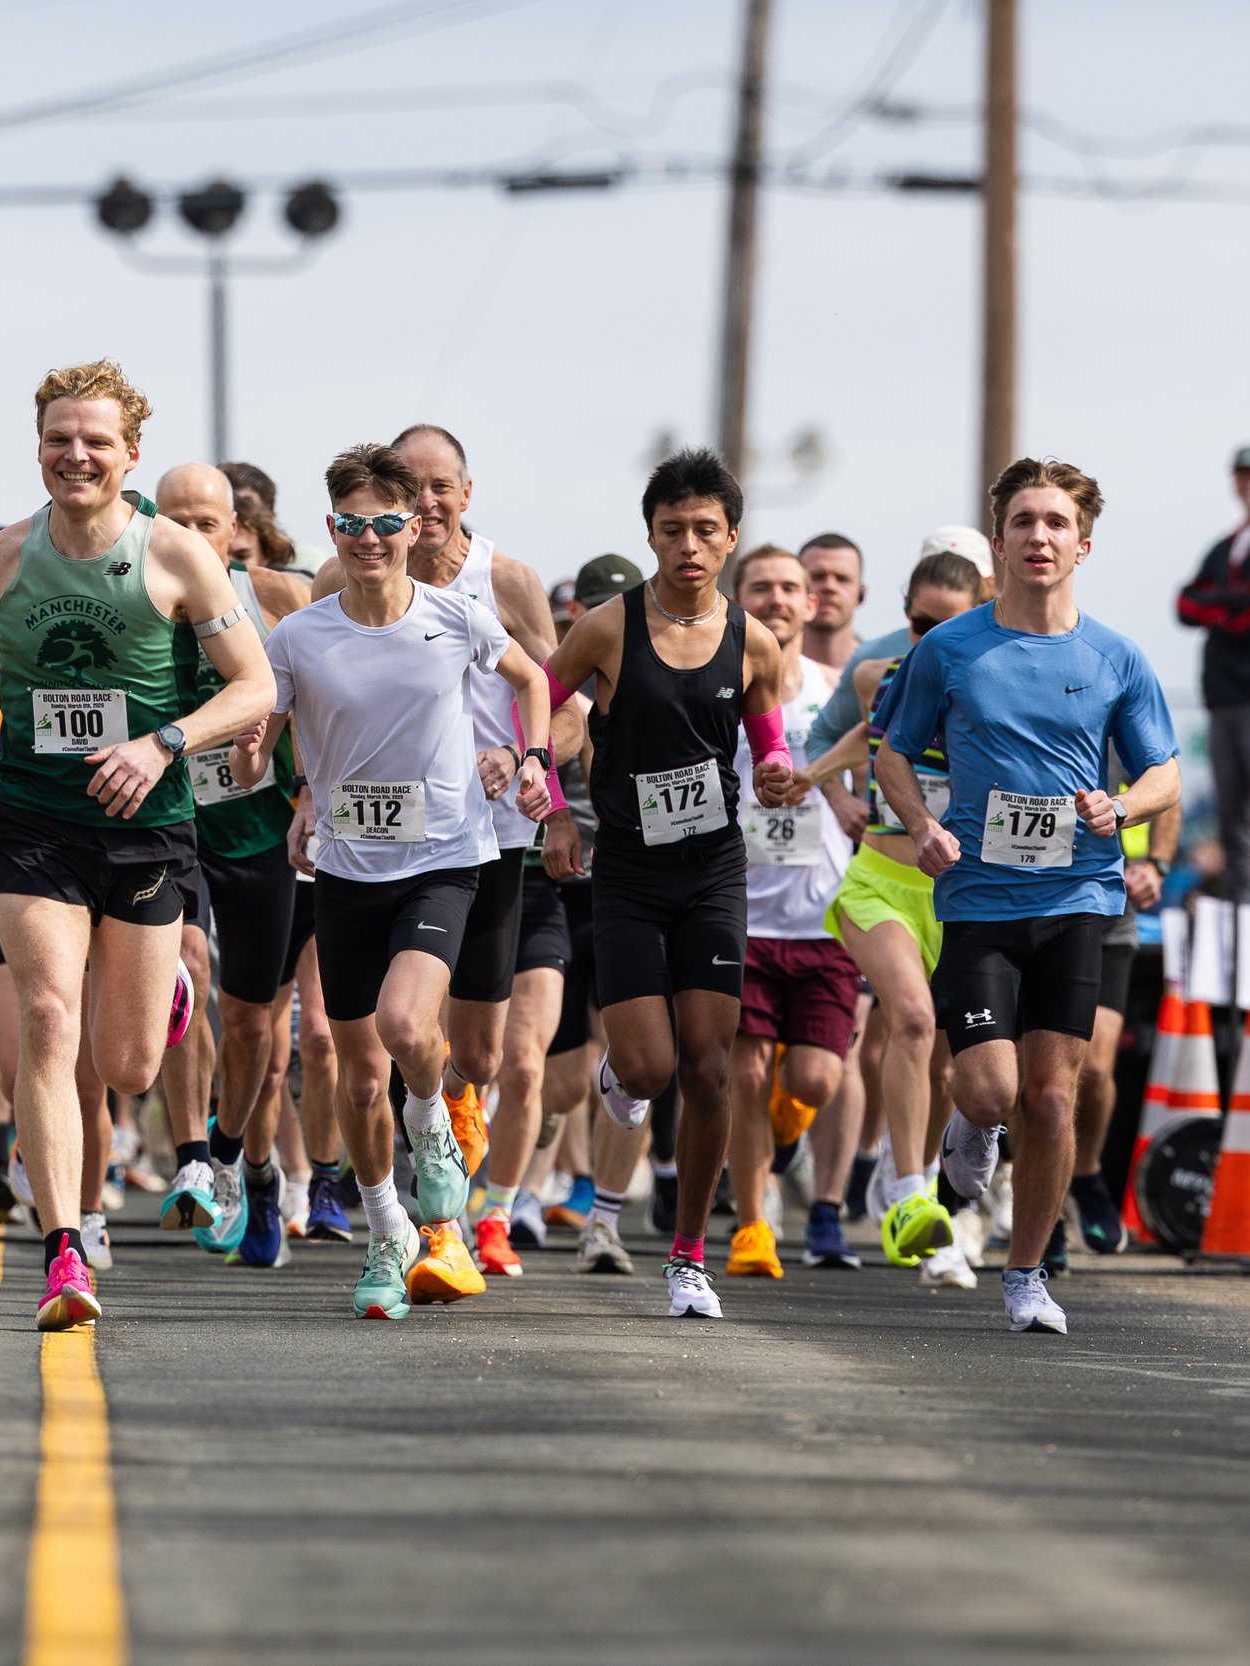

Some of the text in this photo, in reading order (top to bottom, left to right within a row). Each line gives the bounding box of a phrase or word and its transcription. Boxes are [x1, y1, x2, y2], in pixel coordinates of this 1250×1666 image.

[25, 600, 127, 635] MANCHESTER
[43, 693, 112, 703] BOLTON ROAD RACE
[54, 710, 104, 738] 100
[196, 752, 223, 763] BOLTON
[646, 762, 710, 784] BOLTON ROAD RACE
[342, 785, 412, 794] BOLTON ROAD RACE
[659, 780, 708, 814] 172
[1000, 793, 1068, 806] BOLTON ROAD RACE
[353, 800, 402, 827] 112
[366, 826, 389, 834] DEACON
[683, 825, 697, 836] 172
[767, 818, 795, 840] 26
[1009, 810, 1056, 838] 179
[1020, 854, 1035, 863] 179
